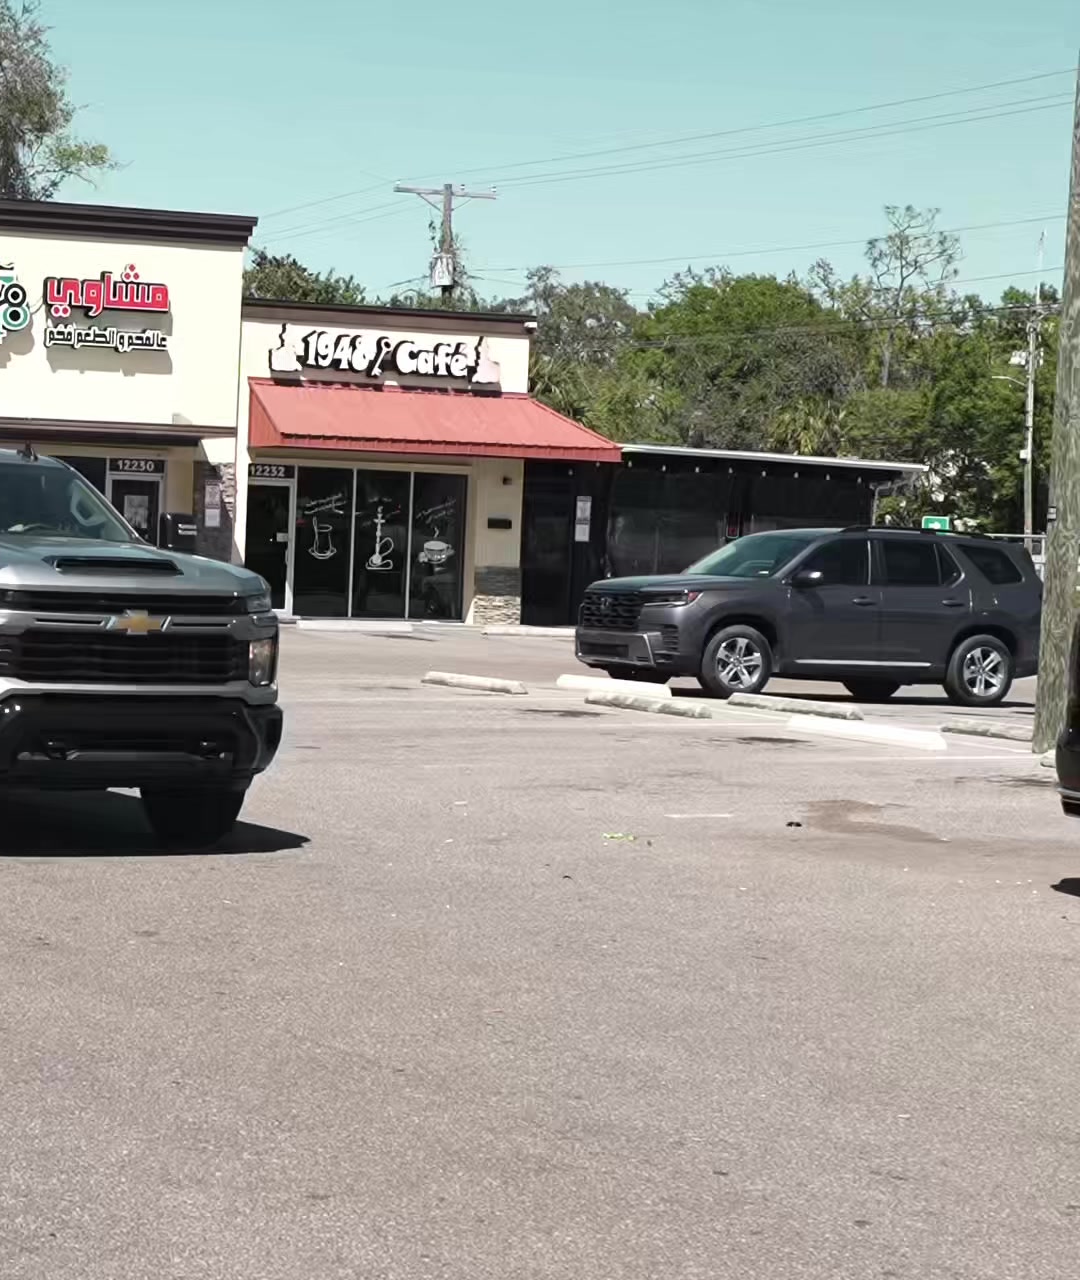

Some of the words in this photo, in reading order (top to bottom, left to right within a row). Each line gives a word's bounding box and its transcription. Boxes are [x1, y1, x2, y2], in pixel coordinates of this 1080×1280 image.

[47, 263, 169, 317] مشاوي
[304, 330, 370, 371] 1948
[396, 341, 468, 377] Café
[118, 459, 155, 472] 12230
[250, 465, 285, 478] 12232
